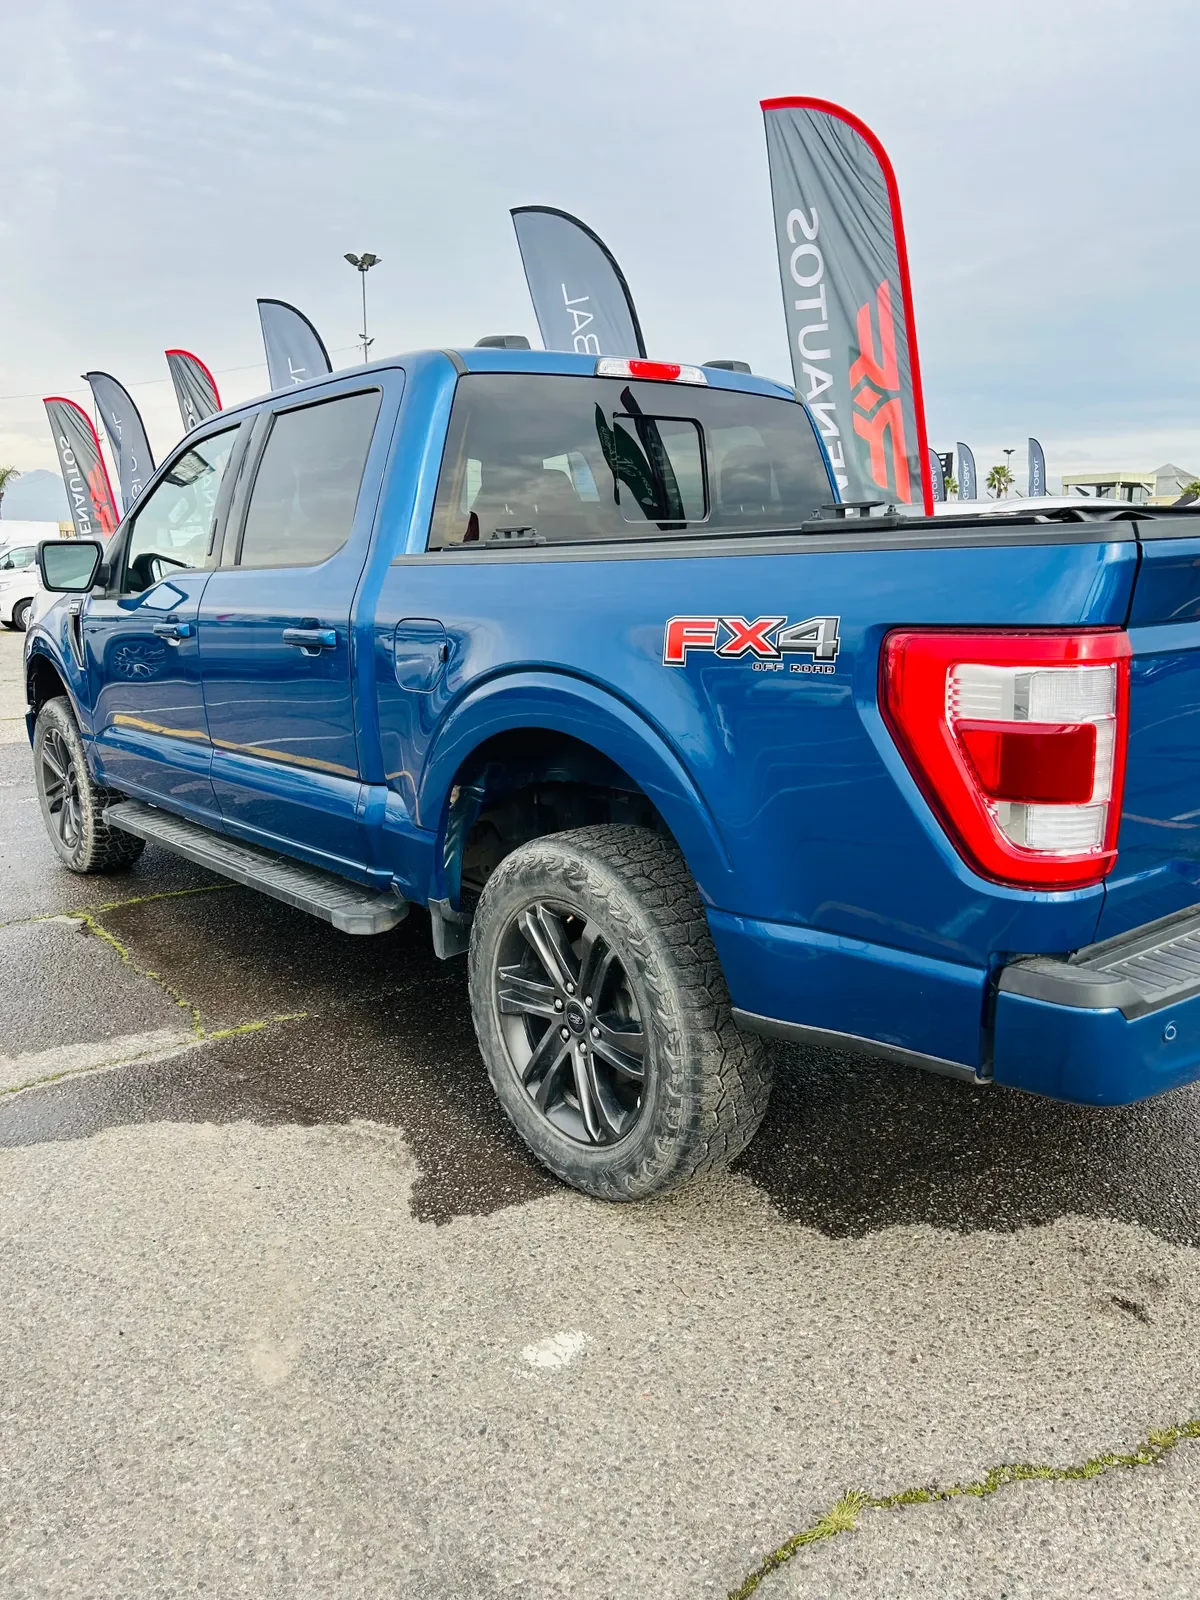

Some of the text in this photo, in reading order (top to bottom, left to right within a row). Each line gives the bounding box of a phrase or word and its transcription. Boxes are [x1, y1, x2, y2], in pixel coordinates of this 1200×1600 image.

[663, 615, 841, 667] FX4
[752, 662, 836, 675] OFF ROAD
